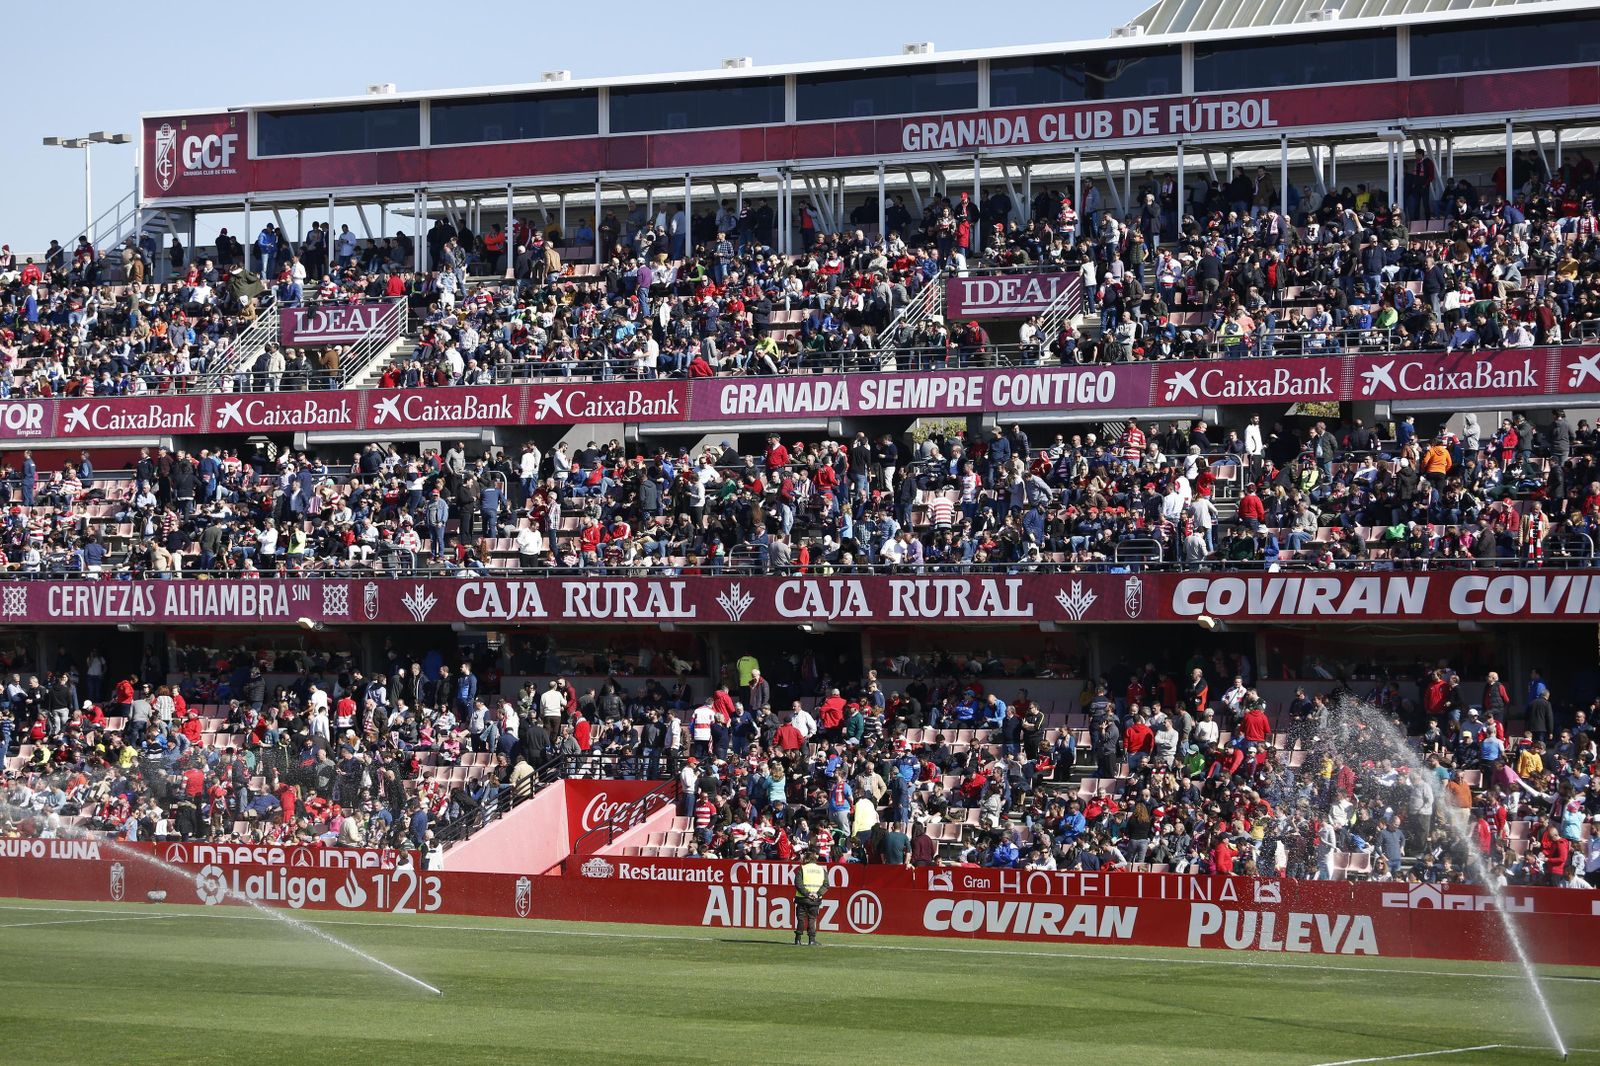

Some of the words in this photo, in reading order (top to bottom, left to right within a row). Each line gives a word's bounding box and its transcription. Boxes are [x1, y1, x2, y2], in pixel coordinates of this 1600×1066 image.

[902, 116, 1030, 151] GRANADA
[1038, 111, 1113, 141] CLUB
[1122, 107, 1160, 136] DE
[1169, 98, 1278, 133] FÚTBOL
[182, 134, 239, 170] GCF
[962, 277, 1069, 306] IDEAL
[294, 307, 387, 334] IDEAL
[720, 381, 850, 414] GRANADA
[858, 375, 985, 411] SIEMPRE
[992, 370, 1116, 406] CONTIGO
[1200, 366, 1334, 398] CaixaBank
[1399, 359, 1538, 393] CaixaBank
[92, 403, 196, 431] CaixaBank
[245, 398, 352, 427] CaixaBank
[403, 393, 513, 422] CaixaBank
[565, 389, 679, 418] CaixaBank
[48, 585, 155, 617] CERVEZAS
[164, 584, 290, 616] ALHAMBRA
[292, 584, 311, 601] SIN
[456, 581, 548, 621] CAJA
[562, 581, 697, 619] RURAL
[775, 579, 873, 620] CAJA
[888, 578, 1034, 618] RURAL
[1172, 576, 1431, 616] COVIRAN
[51, 841, 101, 860] LUNA
[233, 866, 326, 909] LaLiga
[618, 863, 724, 883] Restaurante
[730, 862, 850, 888] CHIKO
[963, 874, 991, 888] Gran
[702, 885, 839, 931] Alliaz
[923, 898, 1139, 939] COVIRAN
[1187, 902, 1380, 955] PULEVA
